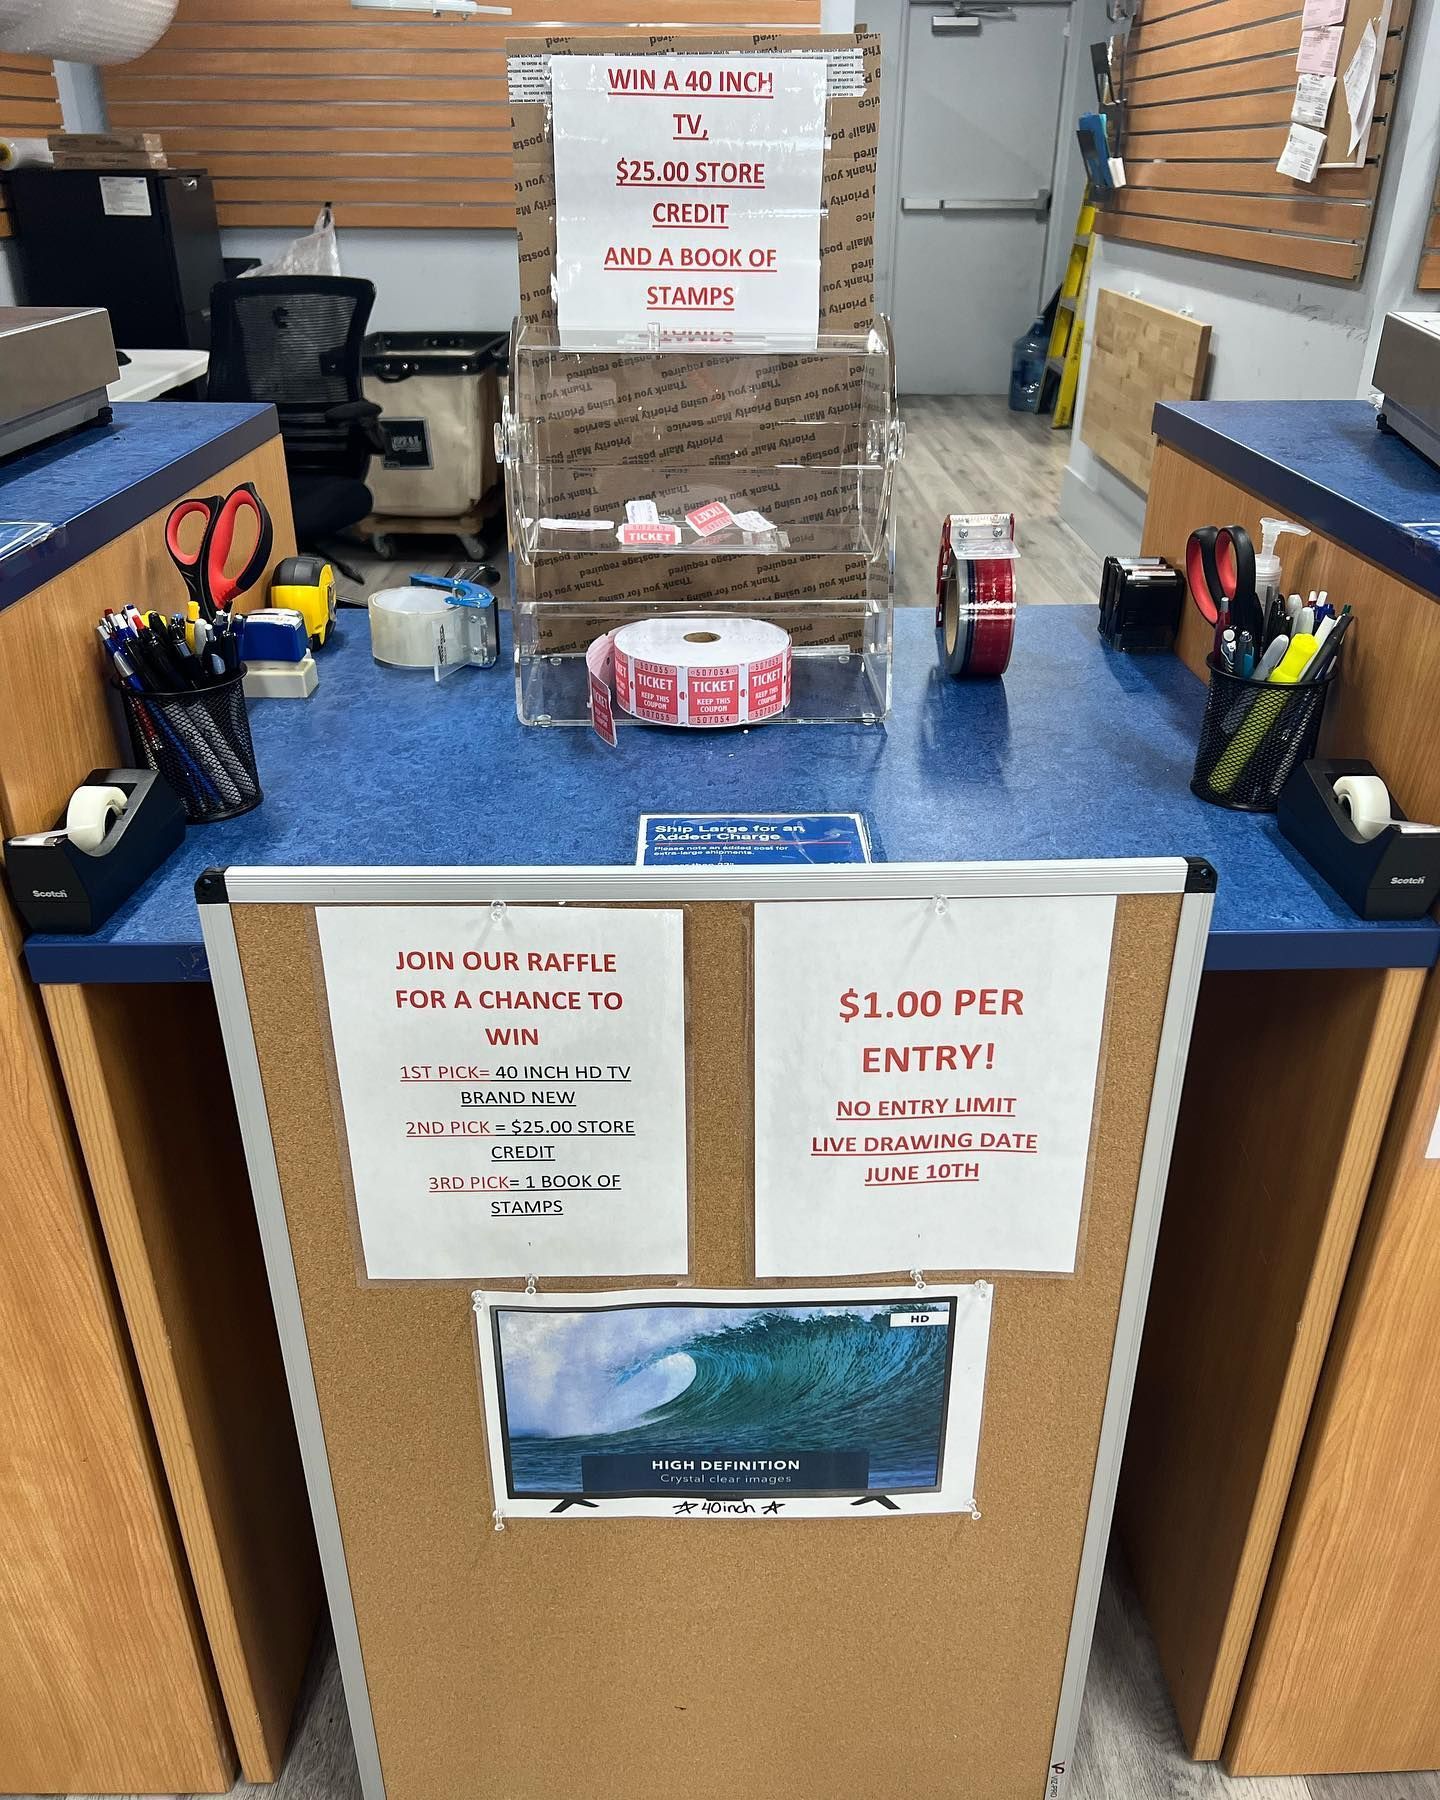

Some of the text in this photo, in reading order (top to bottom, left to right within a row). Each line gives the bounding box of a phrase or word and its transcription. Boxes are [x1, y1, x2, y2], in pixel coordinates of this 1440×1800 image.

[608, 68, 773, 93] WIN A 40 INCH
[673, 114, 708, 139] TV,
[616, 158, 765, 184] $25.00 STORE
[824, 170, 843, 183] you
[526, 174, 545, 188] you
[830, 188, 870, 206] Priority
[653, 204, 729, 224] CREDIT
[604, 248, 777, 268] AND A BOOK OF
[822, 280, 842, 293] you
[647, 286, 734, 306] STAMPS
[829, 297, 867, 314] Priority
[804, 390, 819, 402] for
[822, 384, 840, 396] you
[548, 380, 687, 422] Thank you for using Priority
[573, 378, 781, 435] Thank you for using Priority Service
[735, 401, 772, 417] Priority
[774, 394, 802, 408] using
[594, 437, 631, 452] Priority
[687, 434, 724, 451] Priority
[779, 432, 816, 448] Priority
[567, 486, 598, 500] Thank
[659, 484, 689, 498] Thank
[750, 482, 781, 496] Thank
[774, 497, 802, 511] using
[804, 493, 818, 505] for
[629, 532, 671, 541] TICKET
[580, 561, 619, 578] required
[668, 560, 708, 577] required
[757, 558, 797, 575] required
[554, 579, 604, 596] Thank you
[627, 577, 692, 599] Thank you for
[716, 574, 780, 597] Thank you for
[774, 572, 867, 601] Thank you for using
[696, 668, 730, 676] 507054
[752, 668, 781, 687] TICKET
[637, 674, 673, 690] TICKET
[692, 680, 735, 693] TICKET
[640, 692, 670, 703] KEEP THIS
[755, 686, 779, 699] KEEP THIS
[758, 695, 777, 706] COUPON
[644, 700, 666, 710] COUPON
[654, 825, 694, 834] Ship
[699, 825, 748, 834] Large
[753, 824, 778, 832] for
[654, 833, 781, 842] Added Charge
[1390, 876, 1426, 884] Scotch
[32, 890, 68, 898] Scotch
[396, 951, 617, 973] JOIN OUR RAFFLE
[396, 990, 624, 1010] FOR A CHANCE TO
[838, 988, 1024, 1023] $1.00 PER
[485, 1028, 539, 1046] WIN
[862, 1043, 994, 1073] ENTRY!
[400, 1066, 631, 1080] 1ST PICK= 40 INCH HD TV
[460, 1091, 576, 1104] BRAND NEW
[836, 1097, 1016, 1117] NO ENTRY LIMIT
[406, 1120, 444, 1134] 2ND
[450, 1120, 490, 1134] PICK
[511, 1118, 572, 1136] $25.00
[578, 1120, 635, 1134] STORE
[811, 1132, 1038, 1152] LIVE DRAWING DATE
[491, 1146, 555, 1160] CREDIT
[864, 1162, 979, 1182] JUNE 10TH
[429, 1174, 621, 1190] 3RD PICK= 1 BOOK OF
[491, 1200, 563, 1214] STAMPS
[910, 1314, 930, 1324] HD
[652, 1460, 800, 1470] HIGH DEFINITION
[660, 1473, 792, 1486] Crystal clear images
